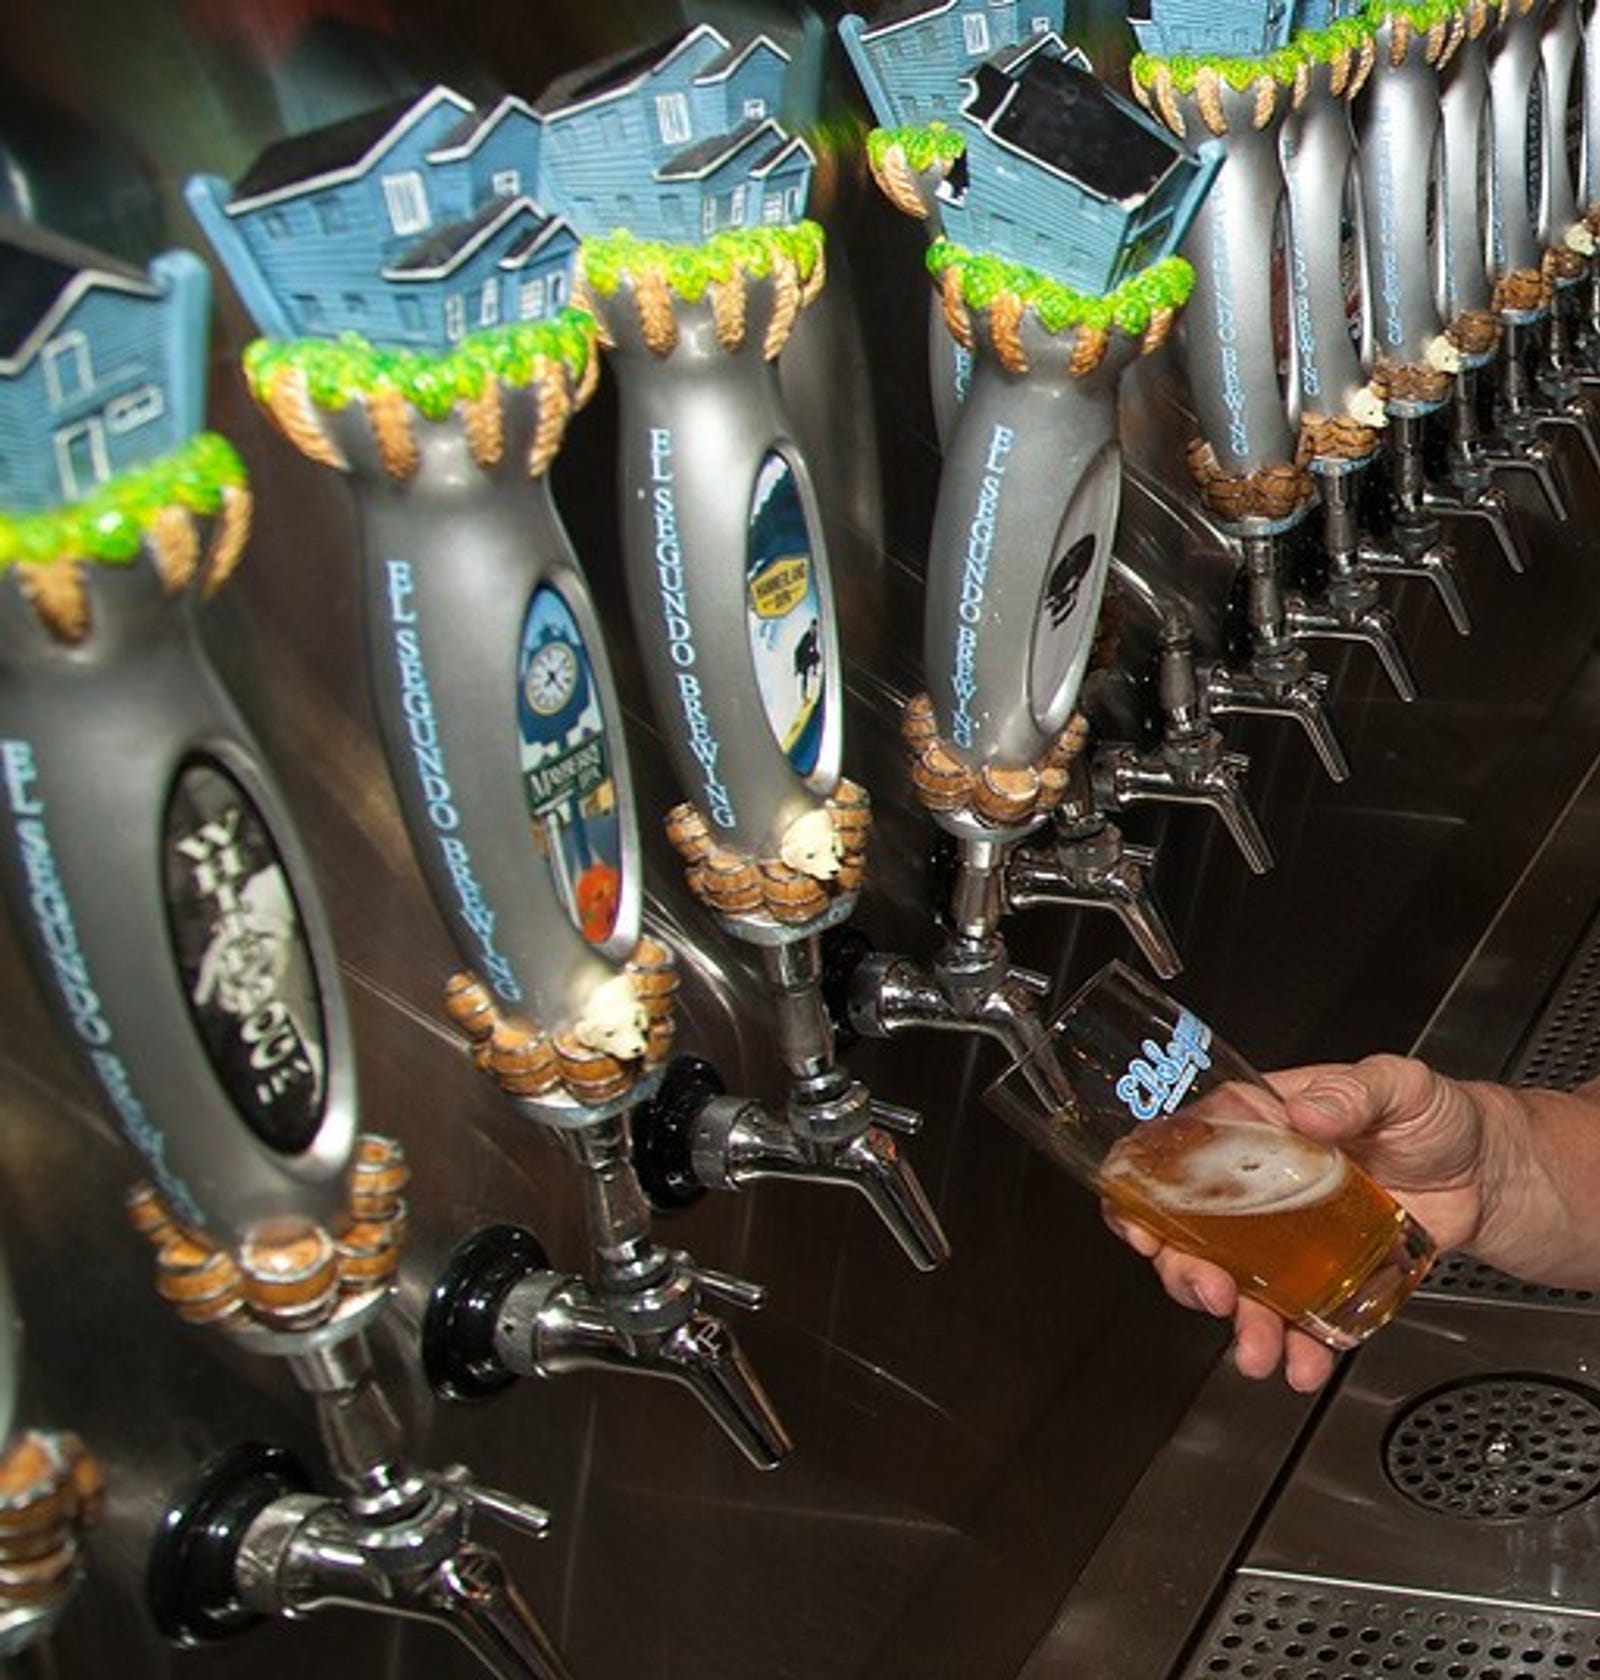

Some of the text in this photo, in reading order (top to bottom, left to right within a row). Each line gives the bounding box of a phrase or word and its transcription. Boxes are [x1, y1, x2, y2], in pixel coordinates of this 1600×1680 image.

[387, 559, 523, 1002] EL SEGUNDO BREWING
[650, 429, 736, 829] EL SEGUNDO BREWING
[952, 423, 1015, 748] EL SEGUNDO BREWING
